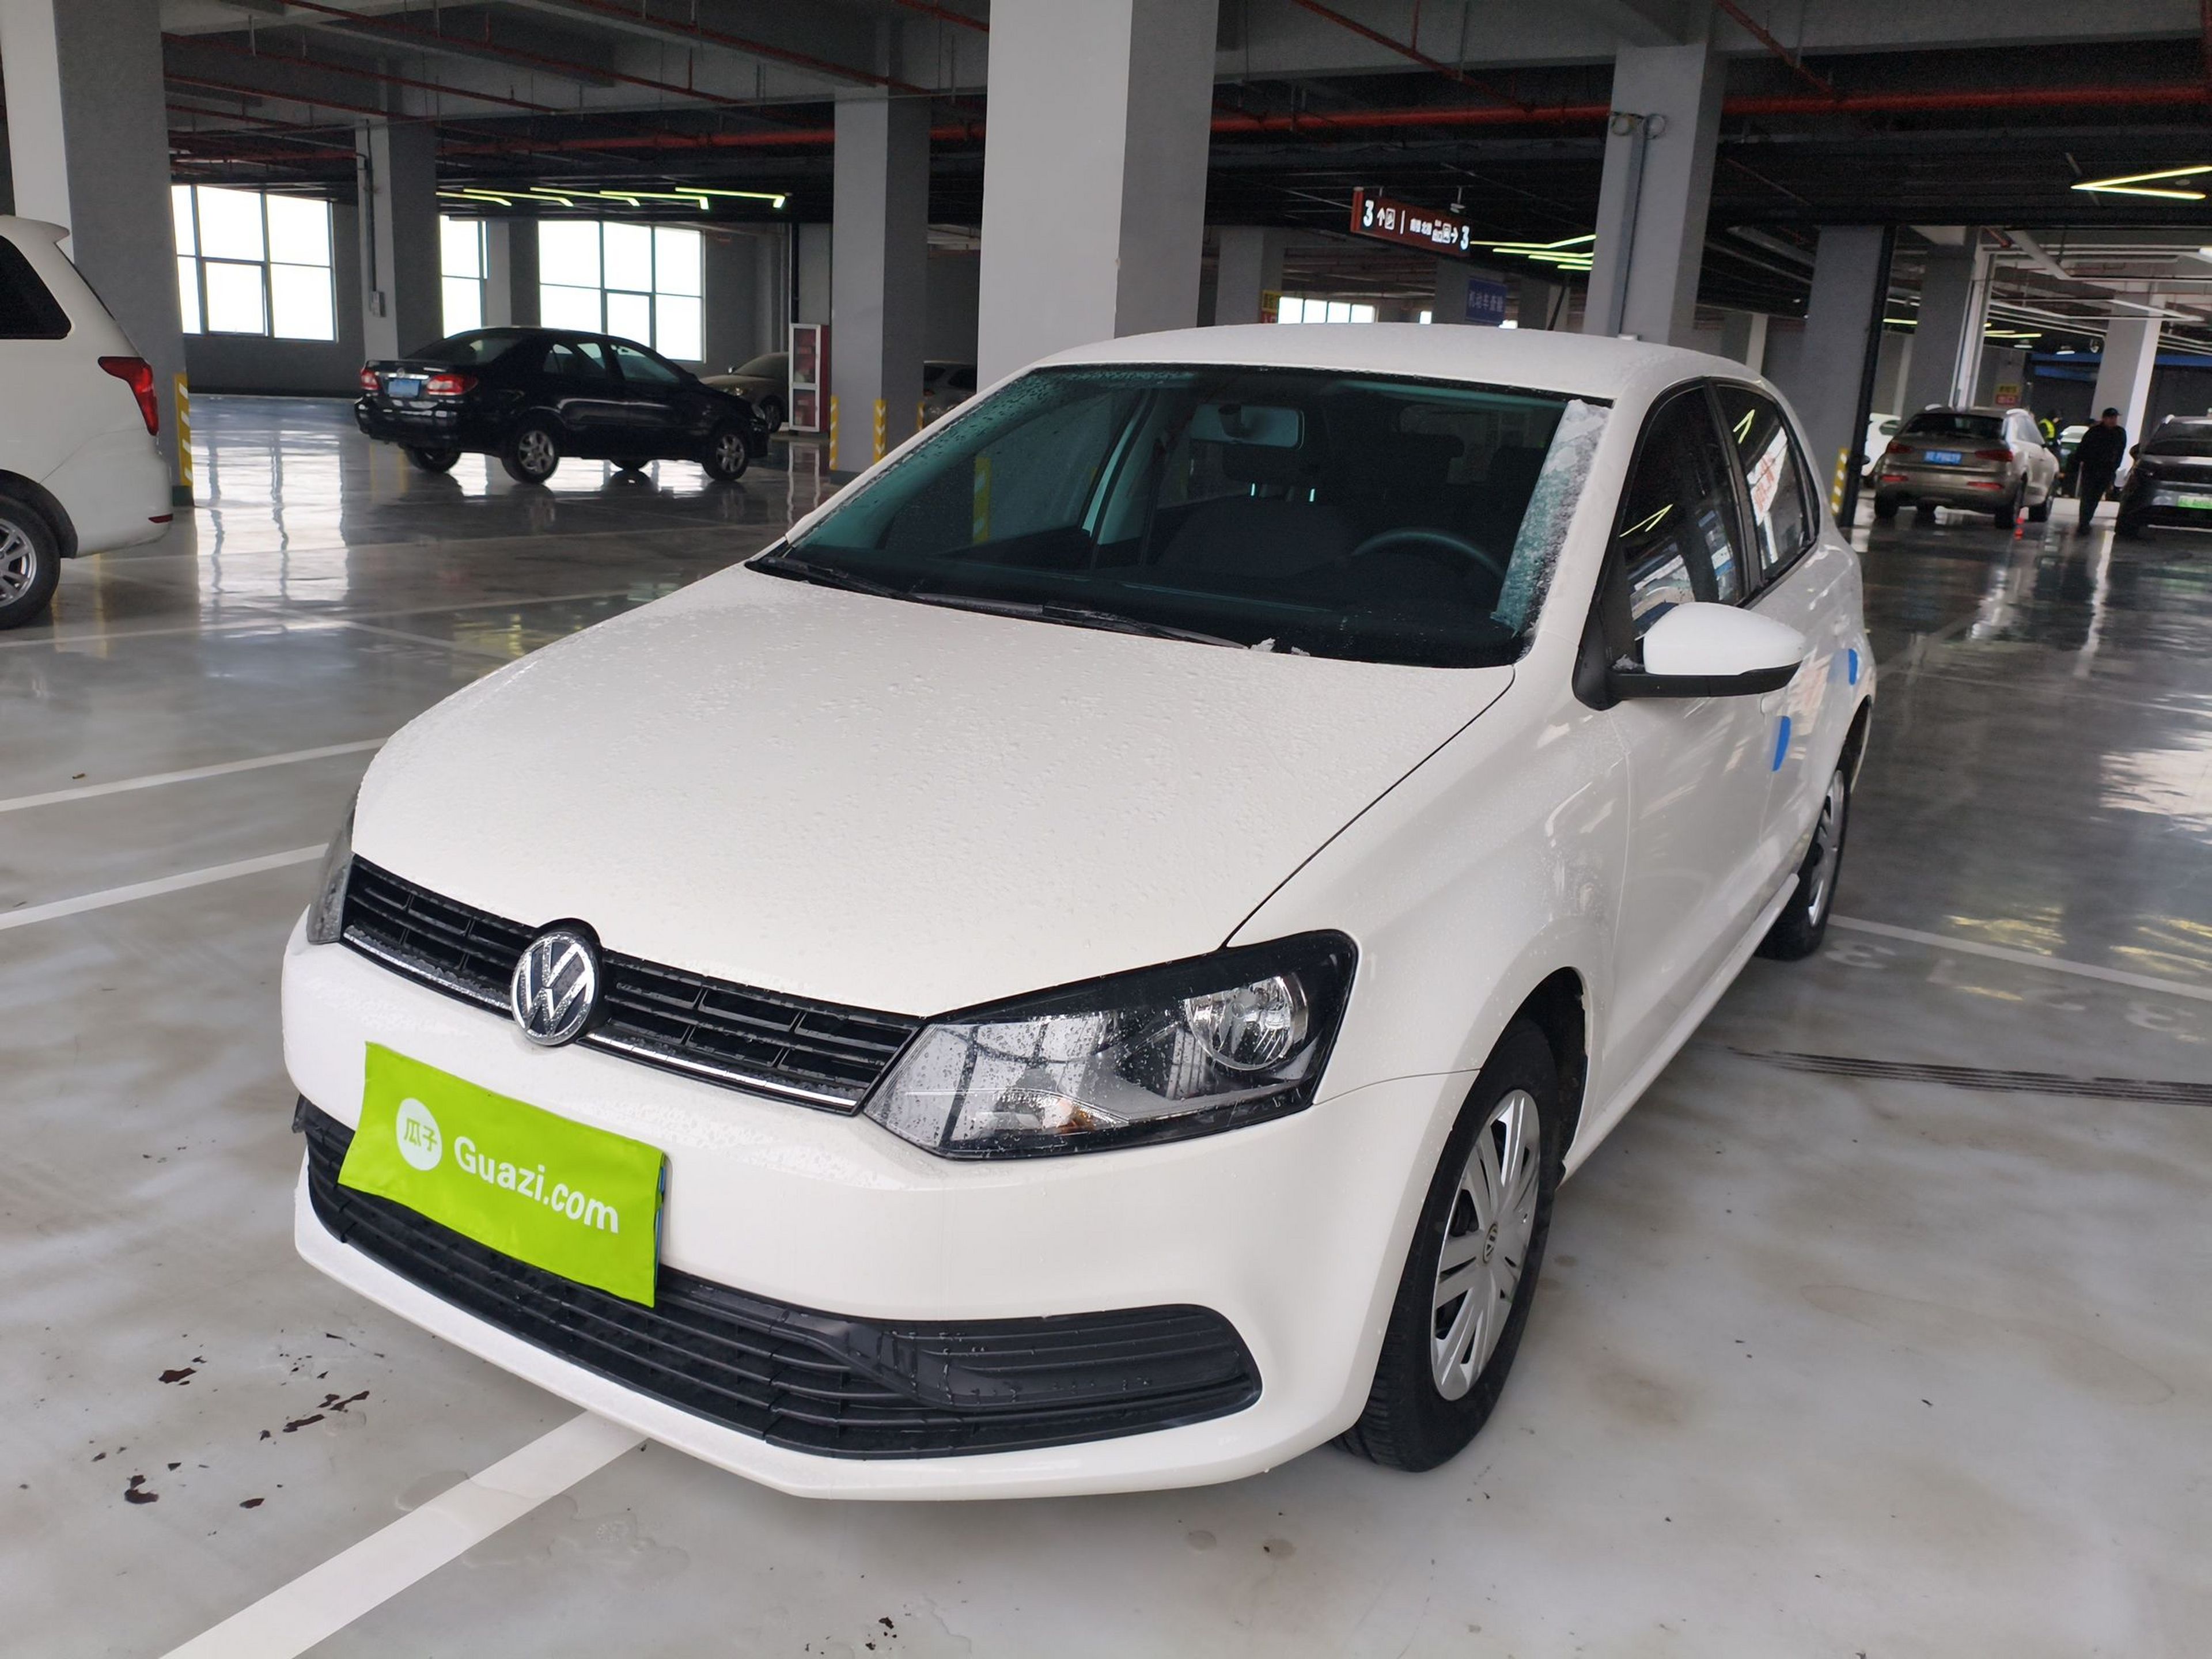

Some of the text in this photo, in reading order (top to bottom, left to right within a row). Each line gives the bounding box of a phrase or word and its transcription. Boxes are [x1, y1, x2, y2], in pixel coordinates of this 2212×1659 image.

[1363, 199, 1374, 227] 3
[1460, 225, 1470, 250] 3
[403, 1116, 438, 1153] 瓜子
[453, 1136, 620, 1234] Guazi.com
